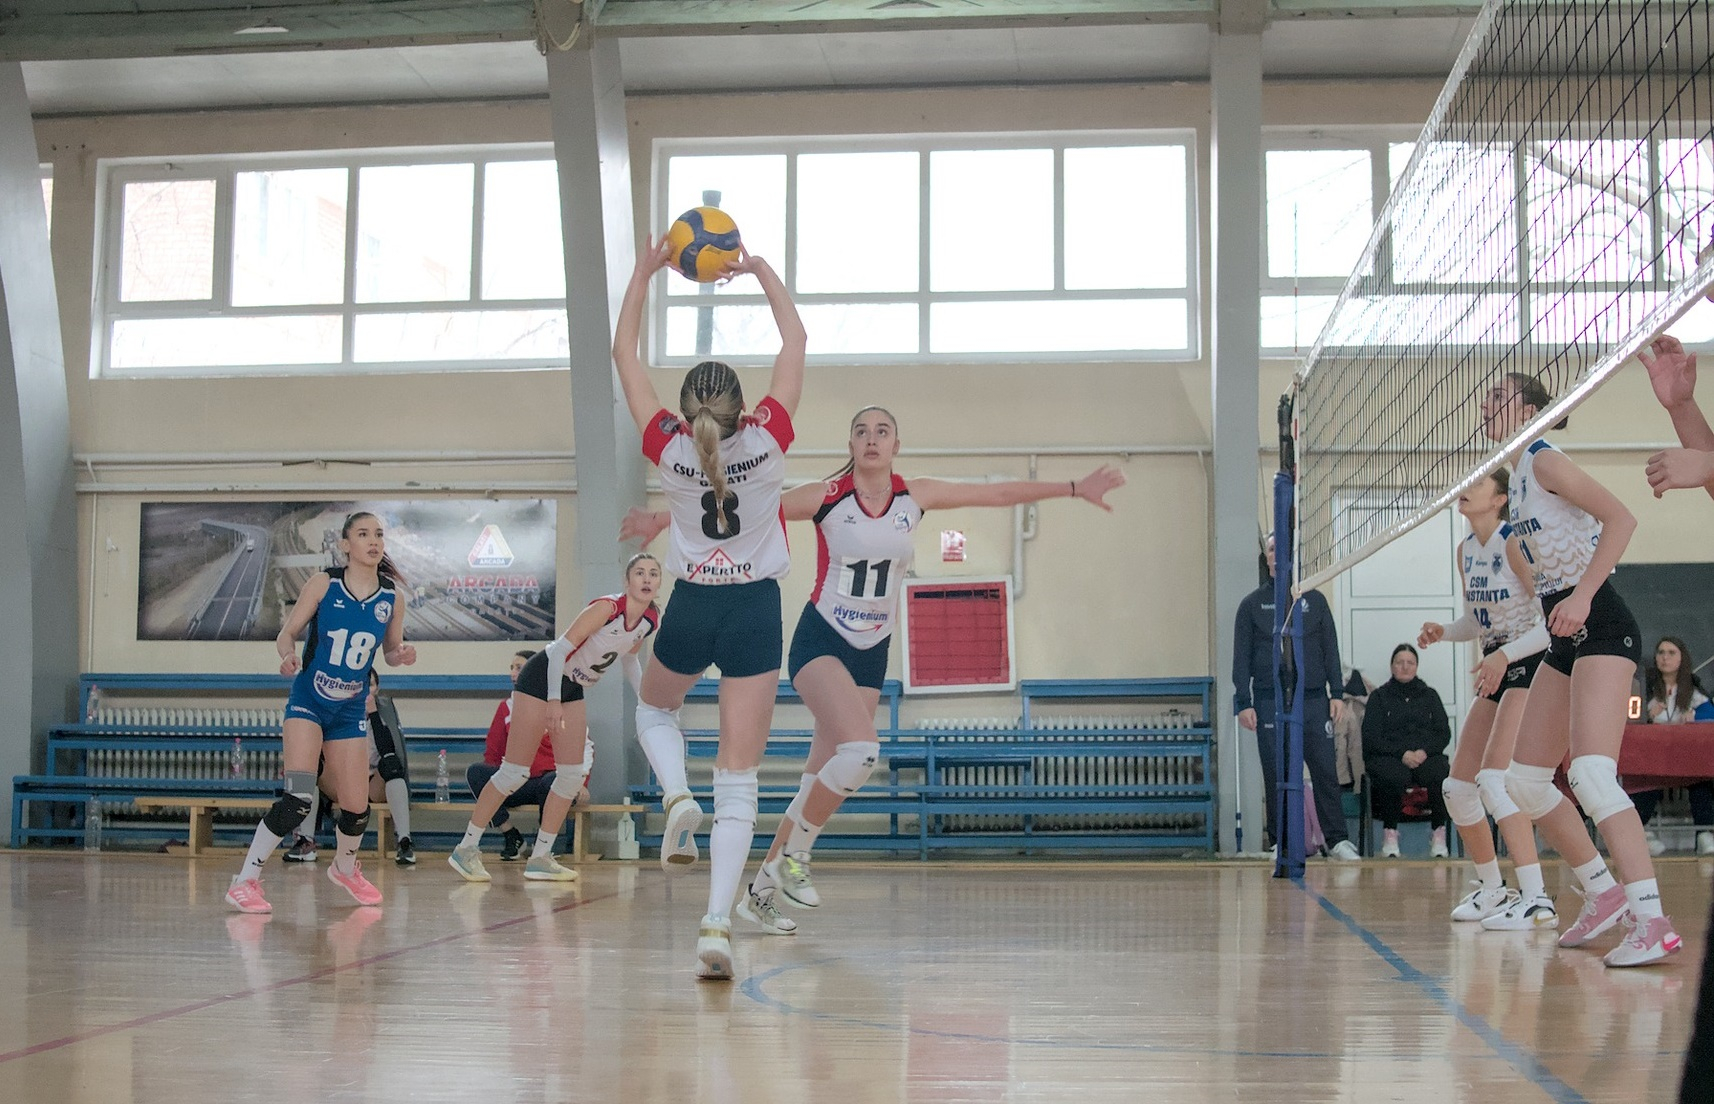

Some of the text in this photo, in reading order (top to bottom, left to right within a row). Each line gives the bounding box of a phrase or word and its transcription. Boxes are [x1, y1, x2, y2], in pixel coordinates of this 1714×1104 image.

[673, 452, 769, 479] CSU-IENIUM
[701, 490, 740, 540] 8
[447, 575, 540, 594] ARCADA
[846, 559, 892, 598] 11
[1470, 576, 1488, 588] CSM
[833, 605, 888, 621] Hygienium
[1474, 607, 1492, 629] 14
[327, 628, 376, 670] 18
[590, 651, 618, 674] 2
[1628, 696, 1641, 719] 0
